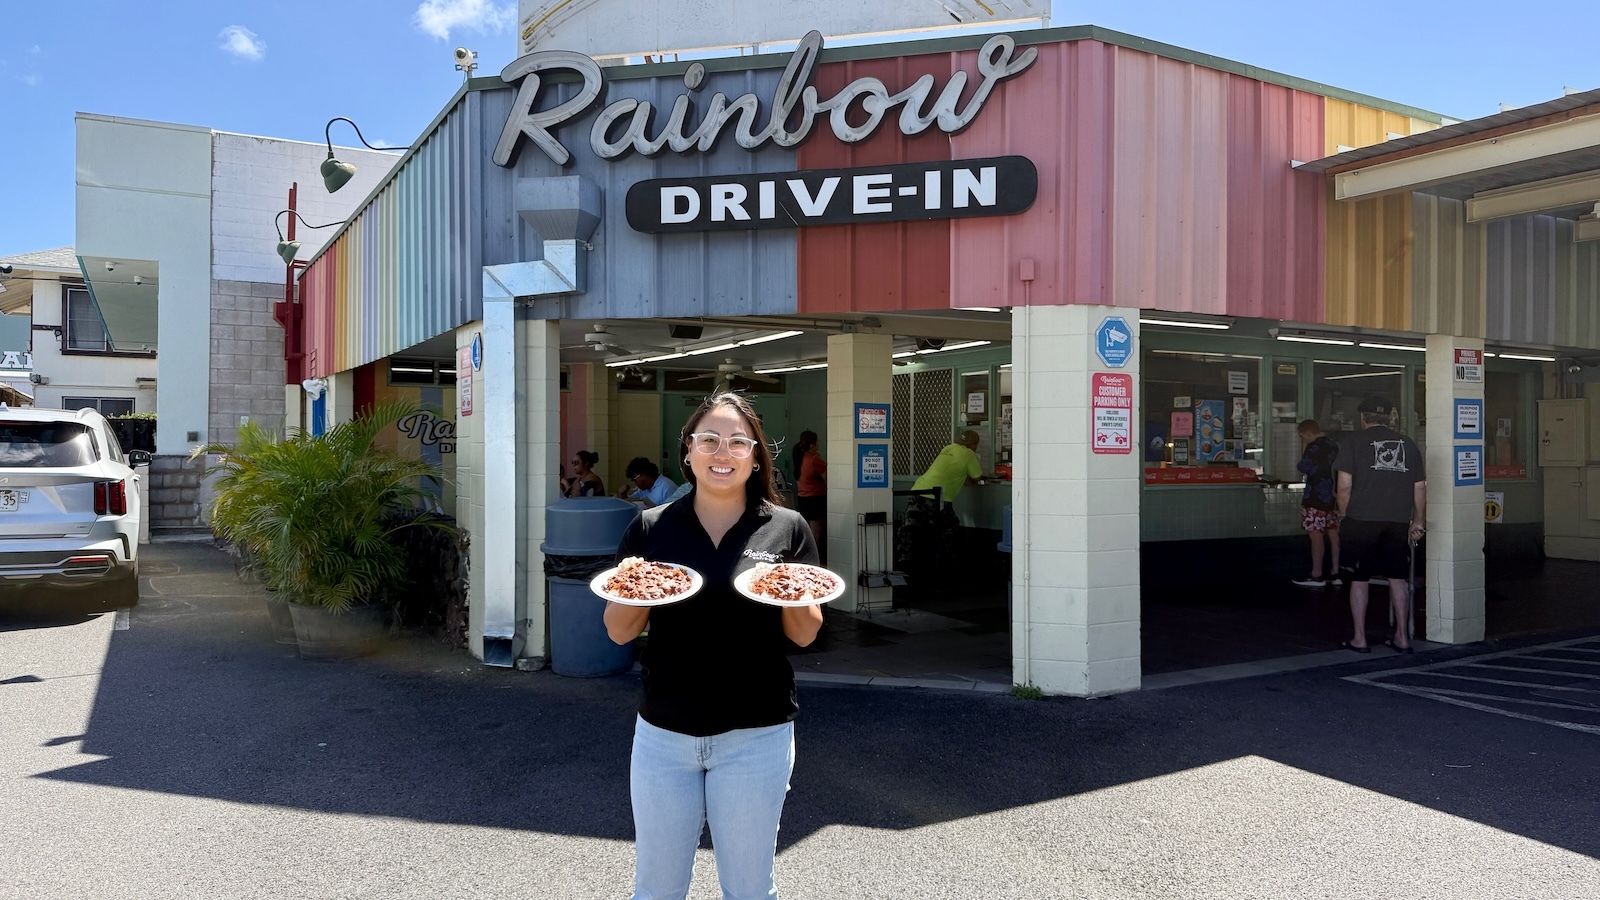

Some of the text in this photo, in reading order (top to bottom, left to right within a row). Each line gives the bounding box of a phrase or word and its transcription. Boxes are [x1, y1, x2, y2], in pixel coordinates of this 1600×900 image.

[492, 30, 1038, 168] Rainbow
[659, 167, 998, 224] DRIVE-IN
[1456, 366, 1465, 380] NO
[1100, 376, 1124, 384] Rainbow
[1099, 386, 1126, 396] CUSTOMER
[1094, 396, 1131, 407] PARKING ONLY
[743, 549, 779, 559] Rainbow
